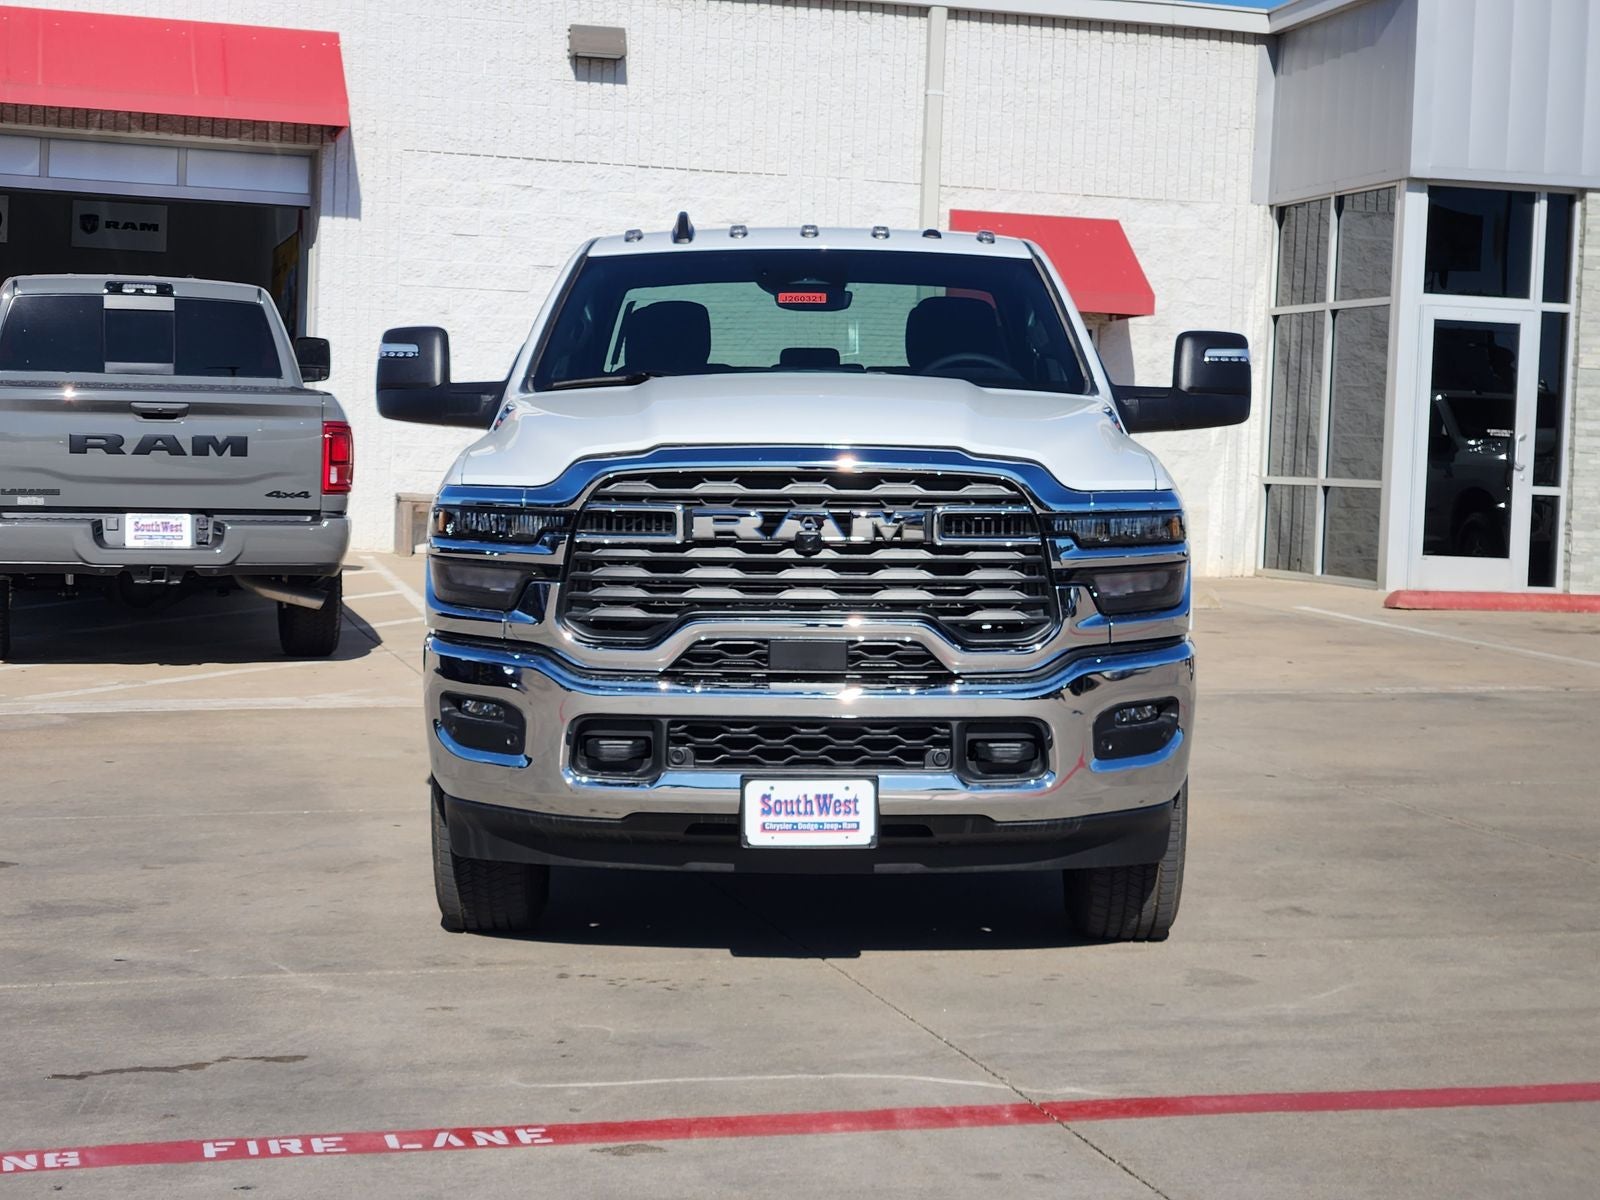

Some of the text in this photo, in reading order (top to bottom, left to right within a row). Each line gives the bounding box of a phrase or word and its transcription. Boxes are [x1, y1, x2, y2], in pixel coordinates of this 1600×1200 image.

[105, 220, 160, 232] RAM
[69, 433, 248, 457] RAM
[265, 490, 311, 499] 4x4
[133, 520, 183, 532] SouthWest
[692, 507, 925, 542] RAM
[760, 793, 860, 817] SouthWest
[764, 821, 858, 832] Chrysler Dodge Jeep Ram
[2, 1127, 554, 1172] NG FIRE LANE
